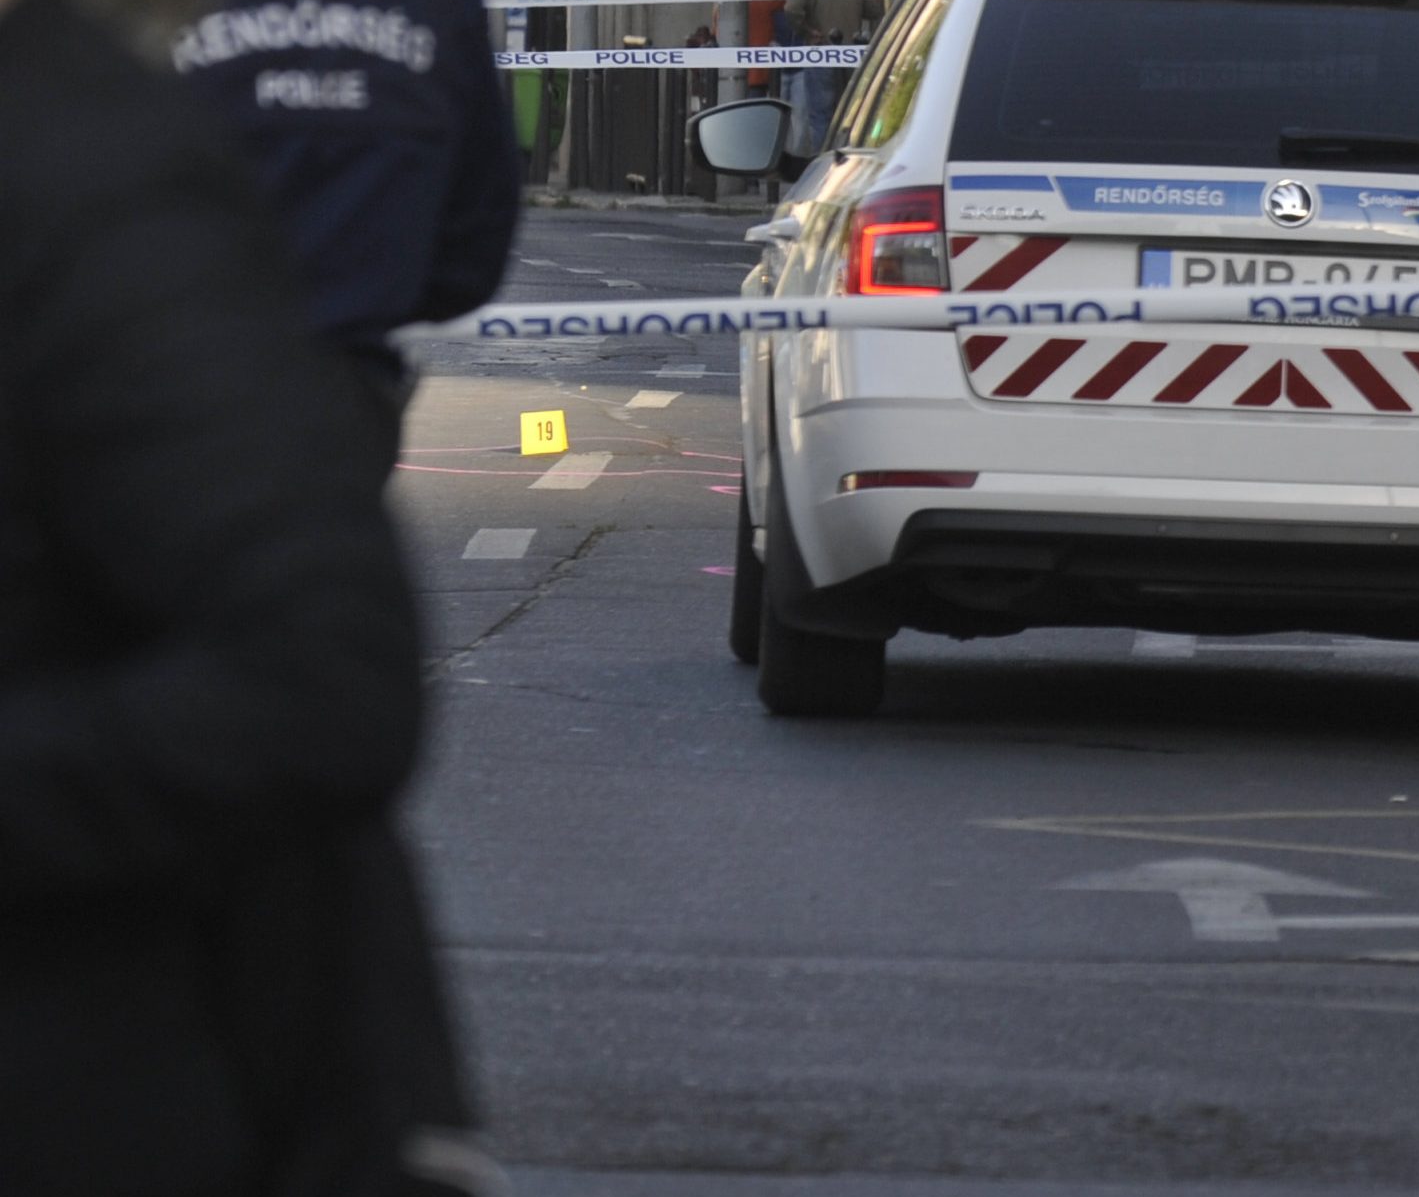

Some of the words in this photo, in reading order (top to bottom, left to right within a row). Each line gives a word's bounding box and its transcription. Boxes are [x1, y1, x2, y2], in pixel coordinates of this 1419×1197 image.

[595, 50, 685, 65] POLICE
[1095, 184, 1226, 207] RENDŐRSÉG
[536, 420, 553, 441] 19
